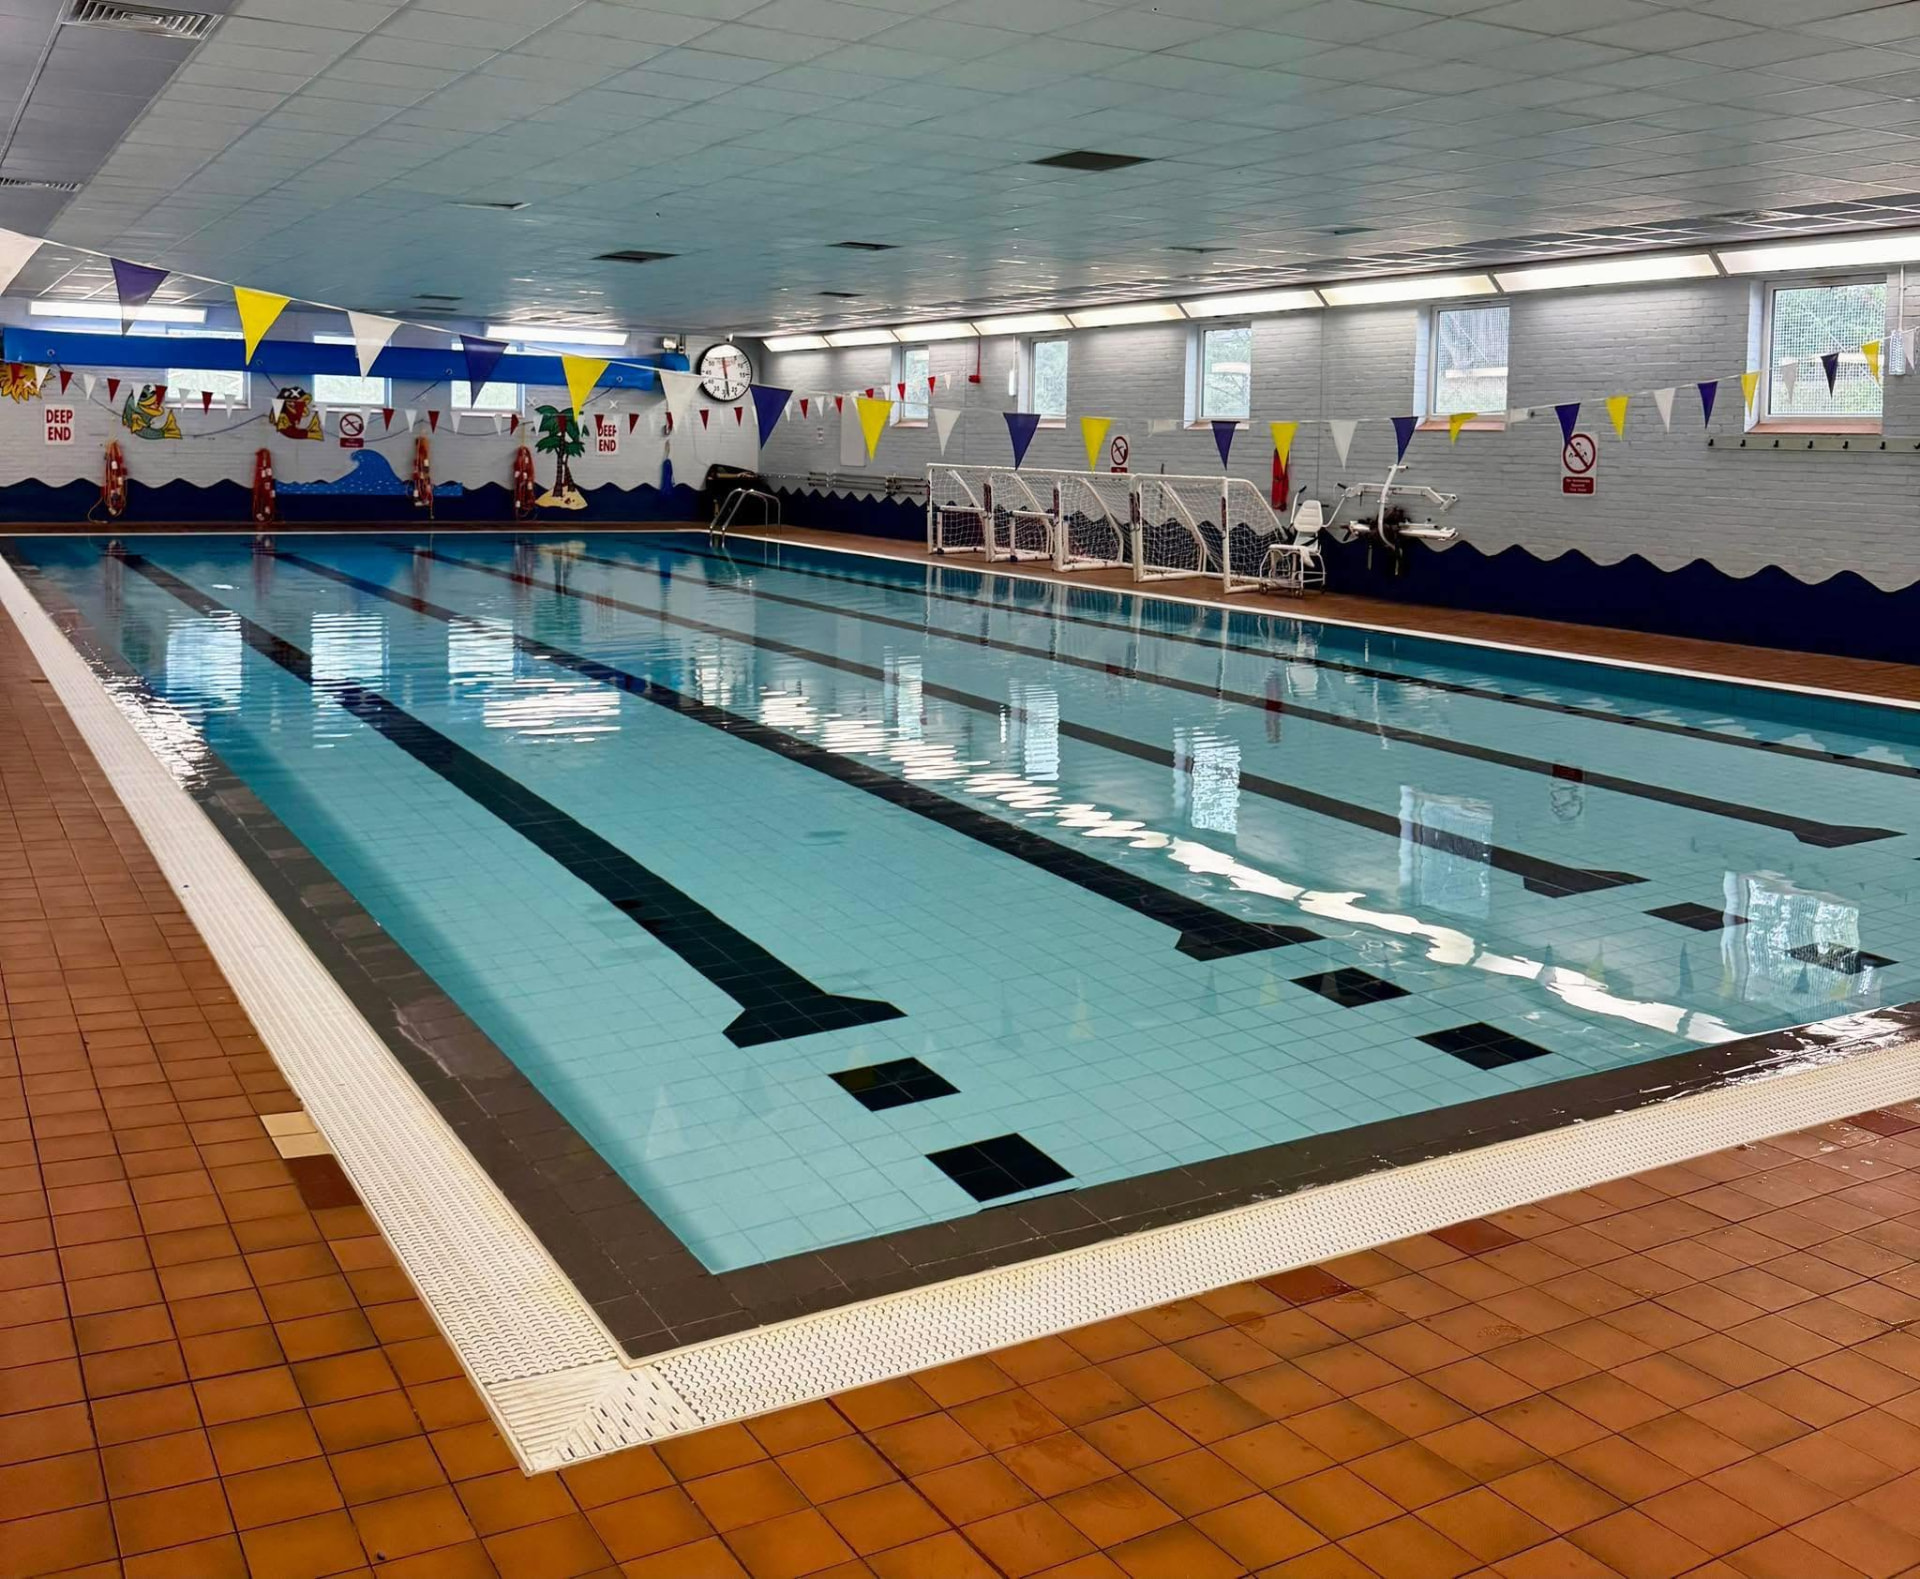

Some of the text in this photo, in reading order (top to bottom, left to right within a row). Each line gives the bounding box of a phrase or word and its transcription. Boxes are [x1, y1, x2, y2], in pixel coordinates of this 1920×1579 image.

[46, 409, 73, 424] DEEP
[48, 426, 71, 441] END
[598, 439, 616, 452] END
